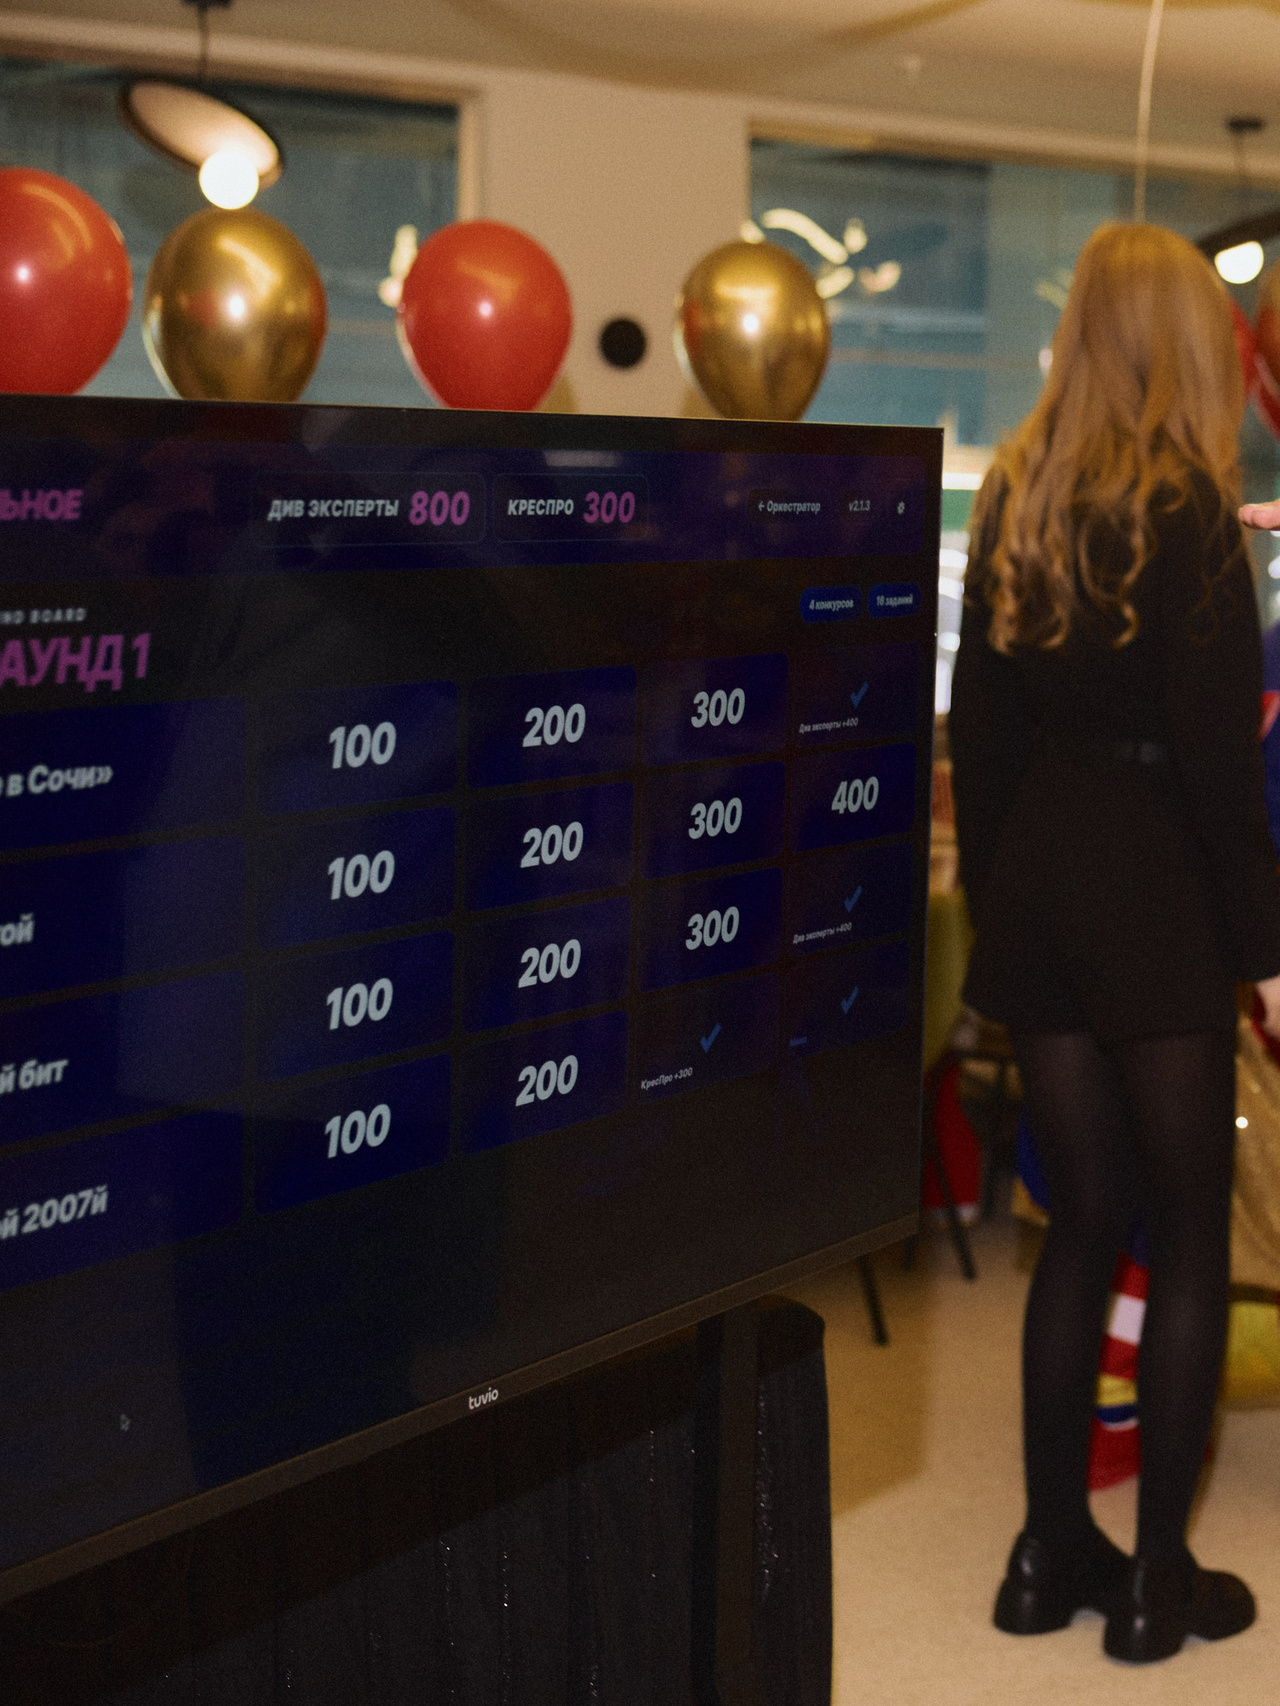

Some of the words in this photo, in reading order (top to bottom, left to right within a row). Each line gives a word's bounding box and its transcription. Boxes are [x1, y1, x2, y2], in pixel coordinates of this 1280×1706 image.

[268, 500, 304, 521] ДИВ
[308, 499, 399, 517] ЭКСПЕРТЫ
[410, 491, 470, 525] 800
[508, 499, 574, 515] КРЕСПРО
[584, 492, 635, 523] 300
[767, 500, 821, 514] Оркестратор
[849, 500, 870, 511] v2.1.3
[809, 600, 815, 609] 4
[815, 600, 853, 611] конкурсов
[0, 635, 123, 692] АУНД
[133, 633, 150, 677] 1
[523, 703, 586, 747] 200
[691, 688, 745, 728] 300
[330, 722, 396, 769] 100
[7, 774, 23, 796] в
[28, 765, 112, 793] Сочи»
[832, 776, 879, 814] 400
[689, 798, 742, 839] 300
[521, 822, 583, 868] 200
[328, 850, 395, 899] 100
[686, 907, 739, 950] 300
[518, 939, 581, 988] 200
[327, 978, 393, 1029] 100
[19, 1060, 67, 1089] бит
[516, 1055, 578, 1106] 200
[641, 1075, 673, 1090] КресПро
[673, 1067, 693, 1079] +300
[326, 1104, 391, 1157] 100
[22, 1186, 108, 1233] 2007й
[469, 1388, 499, 1410] tuvio
